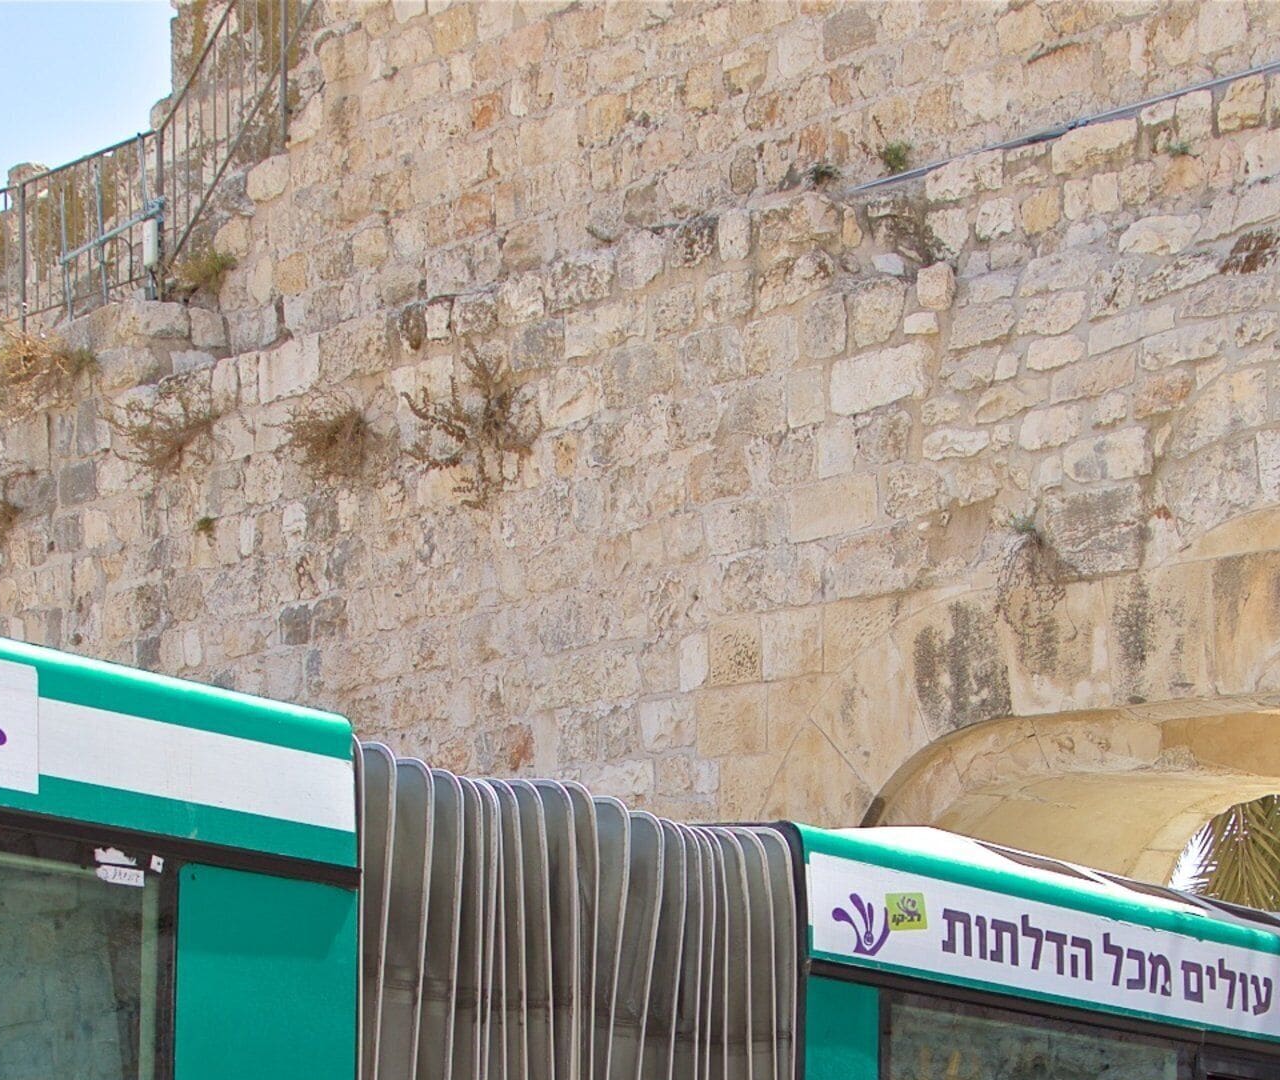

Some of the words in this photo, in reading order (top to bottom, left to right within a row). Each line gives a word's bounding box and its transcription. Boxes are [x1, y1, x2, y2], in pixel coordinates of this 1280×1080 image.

[942, 908, 1094, 981] הדלתות
[1103, 932, 1172, 997] מכל
[1181, 958, 1272, 1017] עולים
